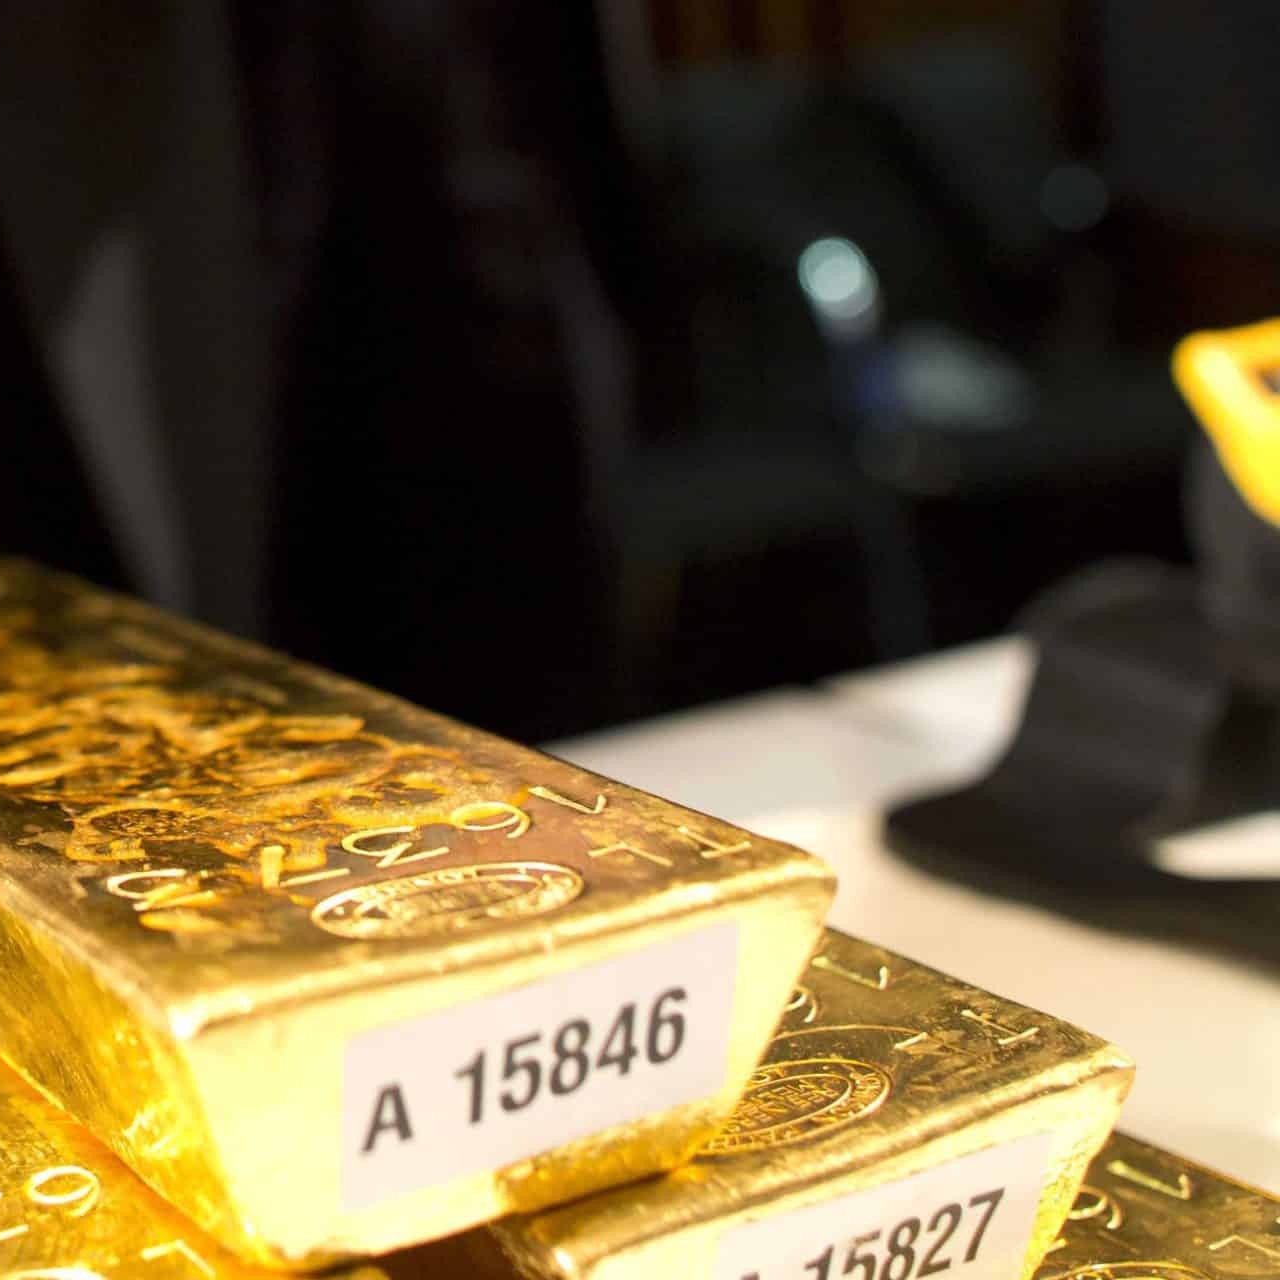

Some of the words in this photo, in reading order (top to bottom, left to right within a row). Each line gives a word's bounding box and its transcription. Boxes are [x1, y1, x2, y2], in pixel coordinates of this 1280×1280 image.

[359, 1081, 415, 1157] A
[453, 986, 688, 1126] 15846
[803, 1186, 1006, 1280] 15827
